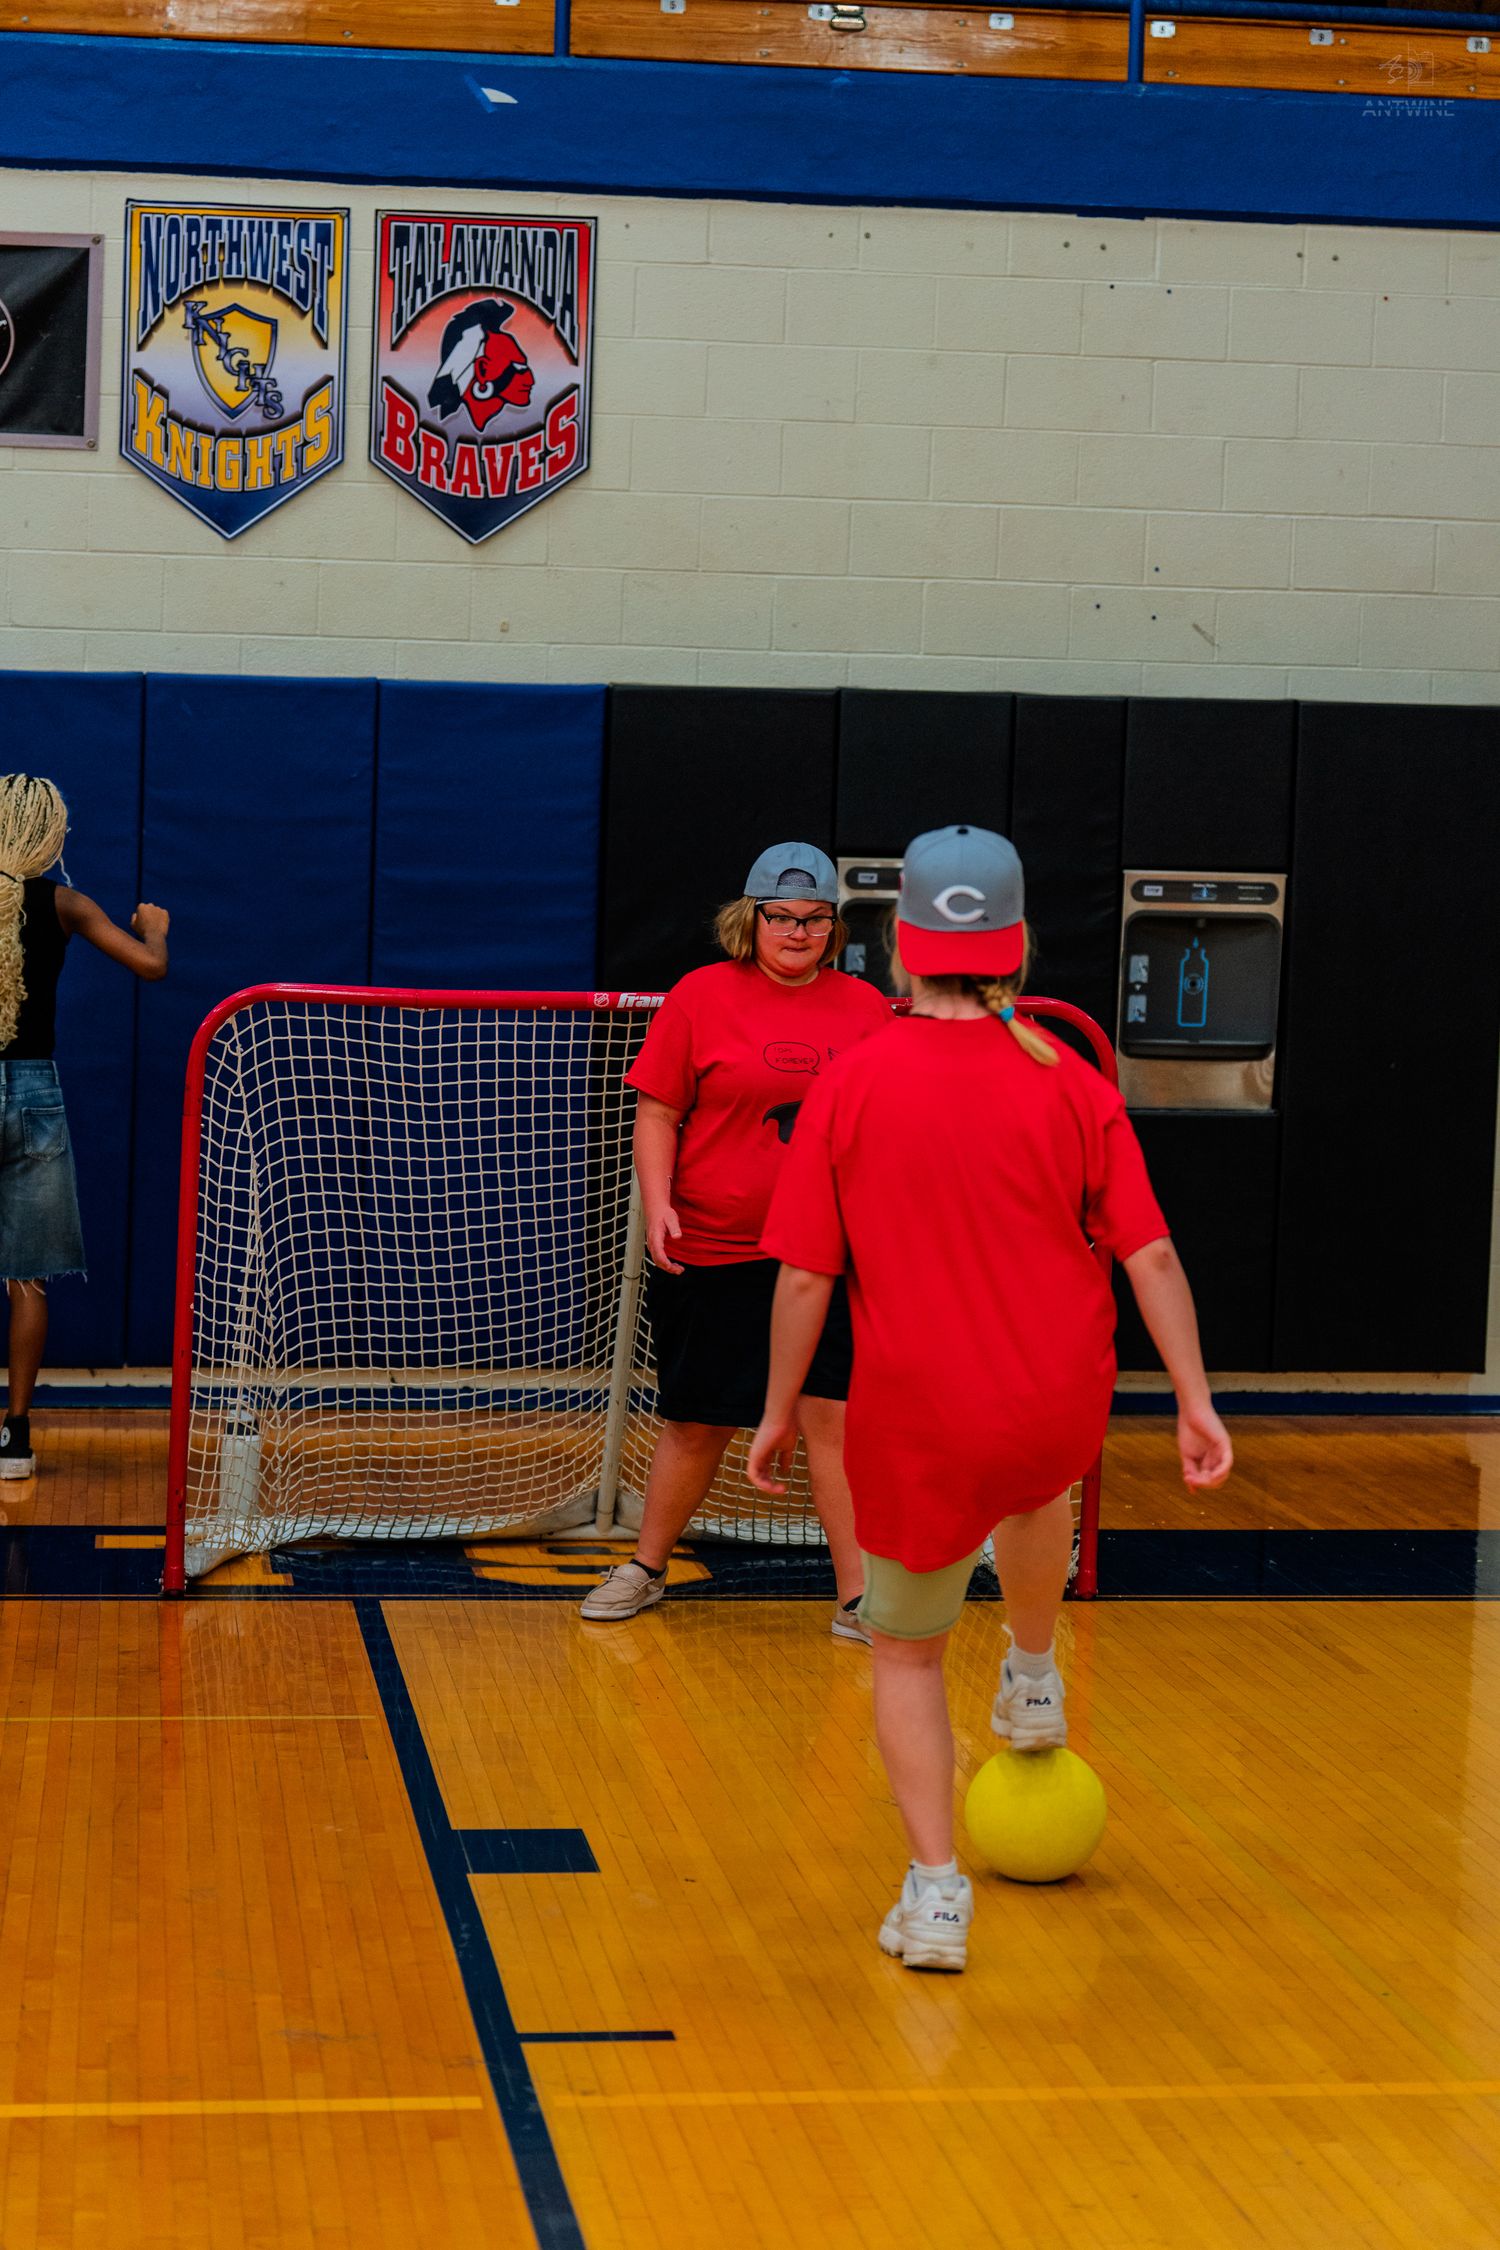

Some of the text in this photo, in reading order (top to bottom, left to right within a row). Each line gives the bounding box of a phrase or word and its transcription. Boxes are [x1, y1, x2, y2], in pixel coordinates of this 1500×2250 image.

[136, 213, 335, 351] NORTHWEST
[389, 221, 580, 366] TALAWANDA
[132, 378, 333, 492] KNIGHTS
[381, 384, 580, 499] BRAVES
[933, 885, 986, 923] C
[617, 992, 666, 1009] Fran
[1026, 1697, 1052, 1707] FILA
[933, 1911, 960, 1922] FILA
